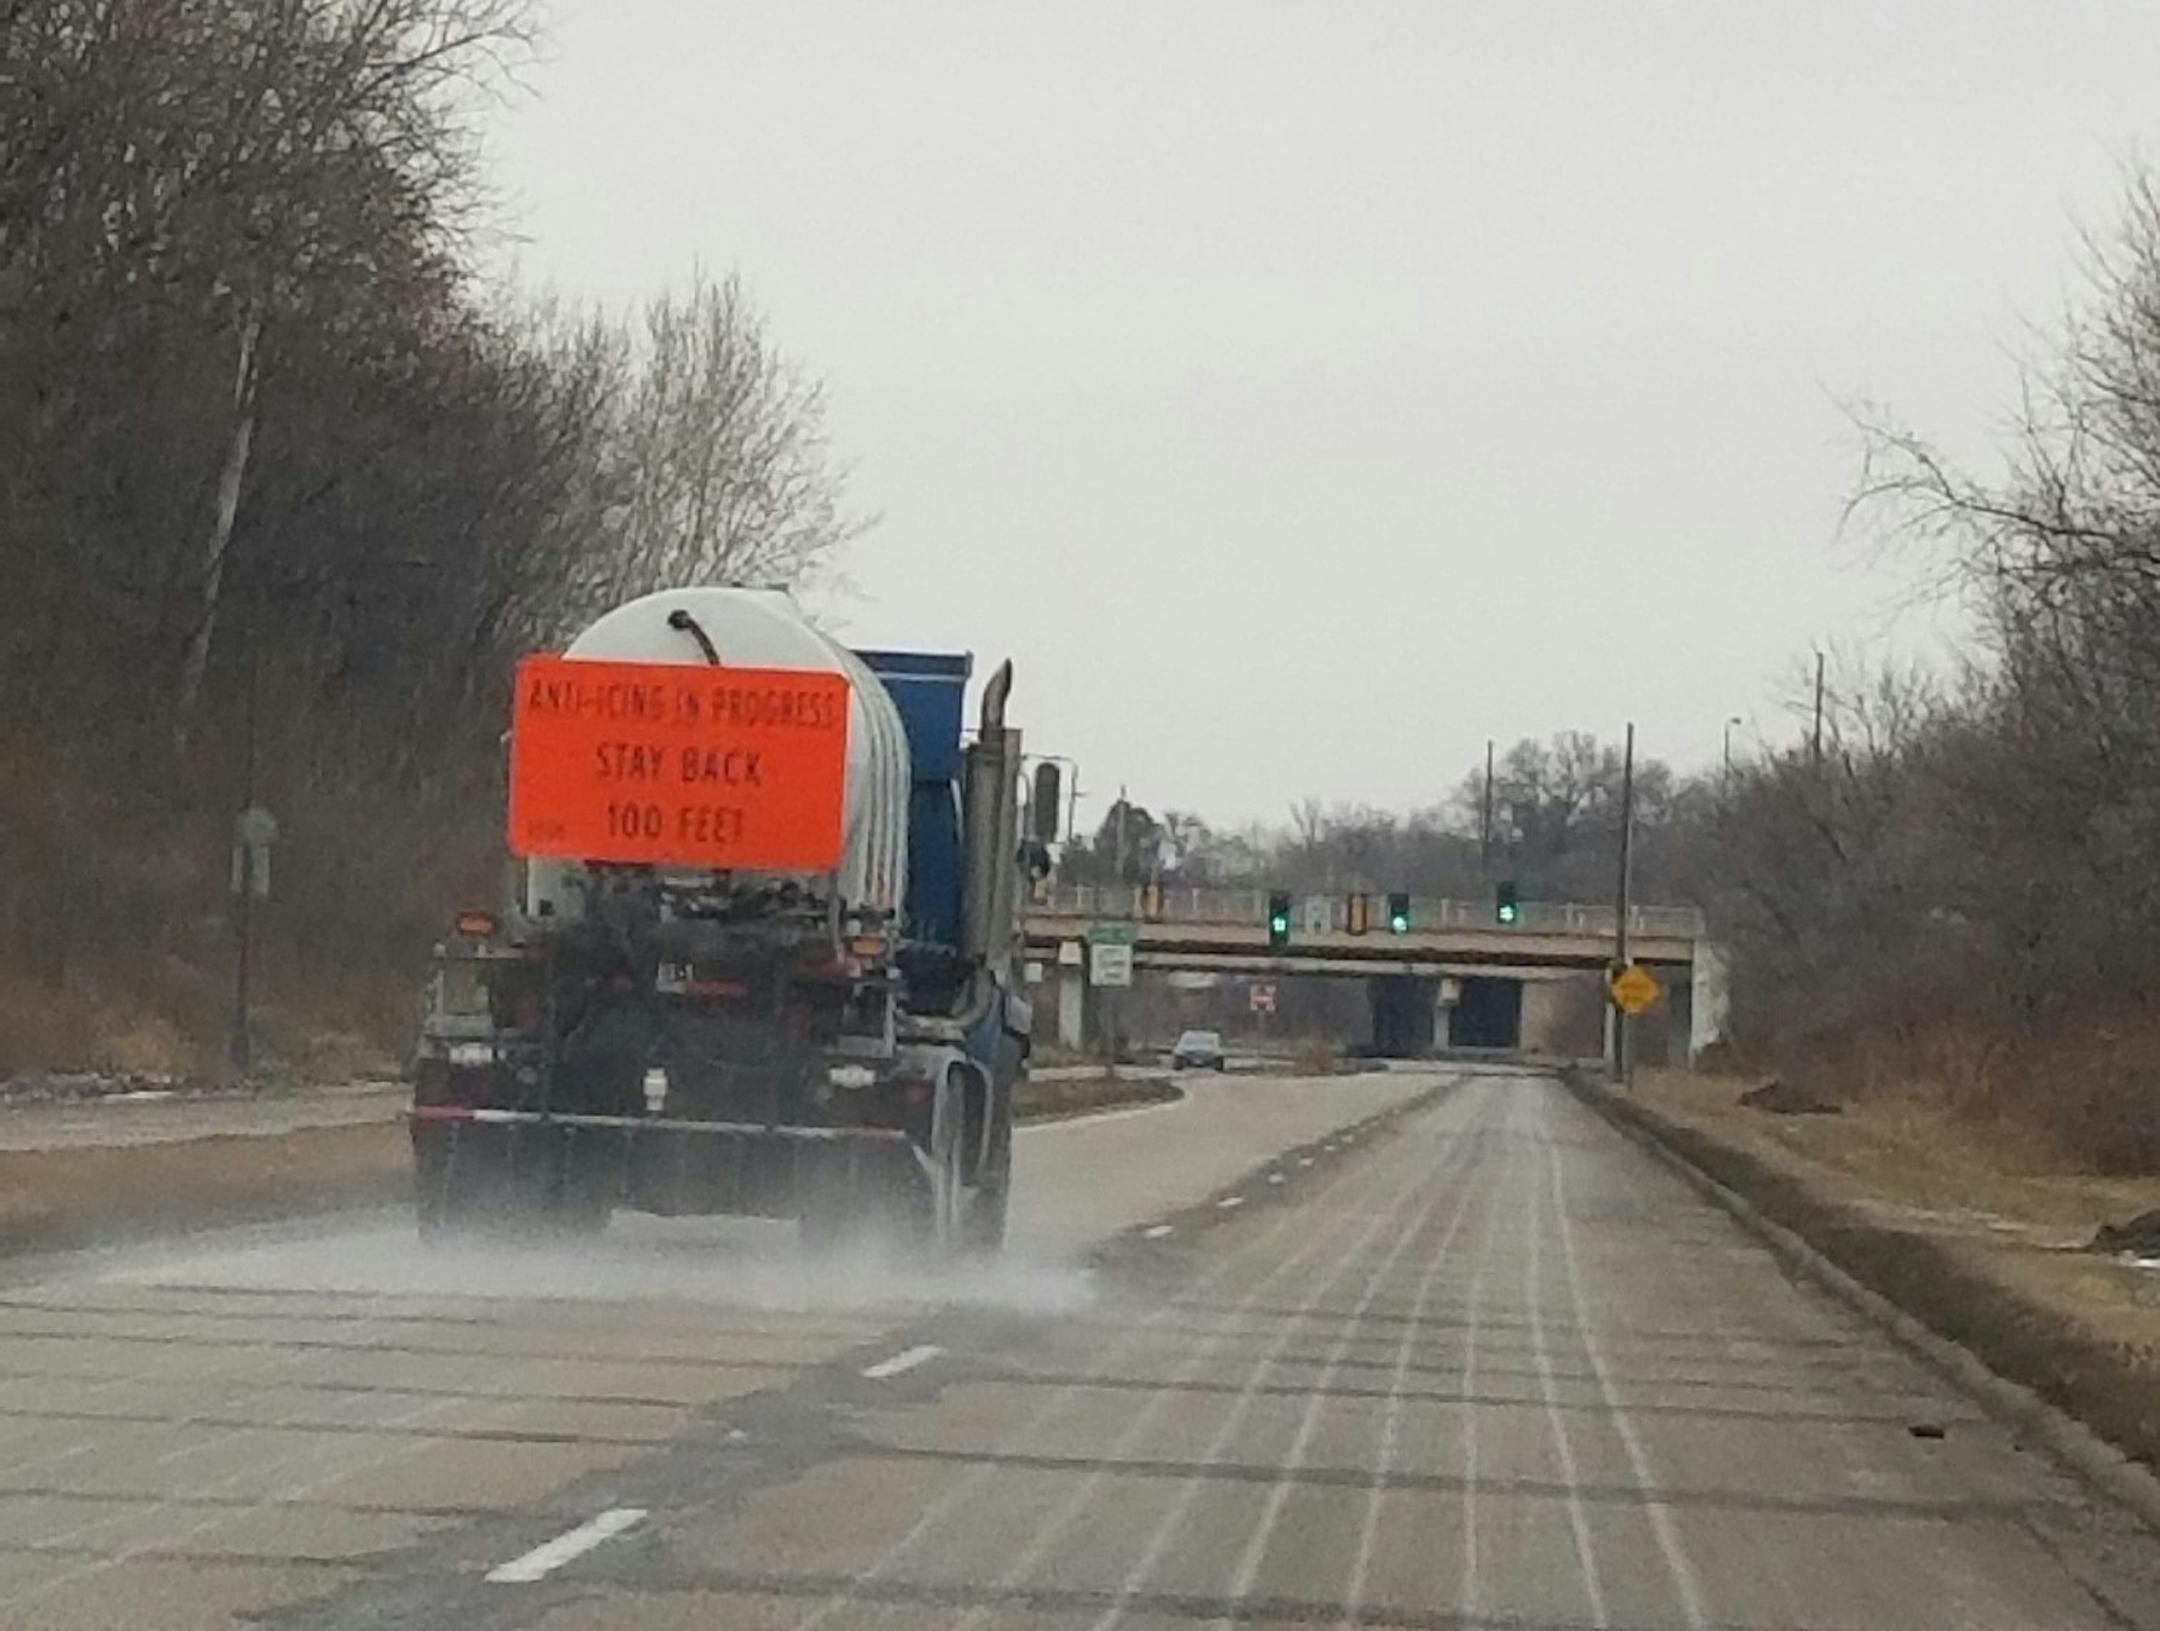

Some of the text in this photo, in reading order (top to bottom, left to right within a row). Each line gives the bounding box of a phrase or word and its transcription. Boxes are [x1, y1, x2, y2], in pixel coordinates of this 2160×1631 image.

[597, 742, 761, 787] STAY BACK
[608, 805, 744, 842] 100 FEET
